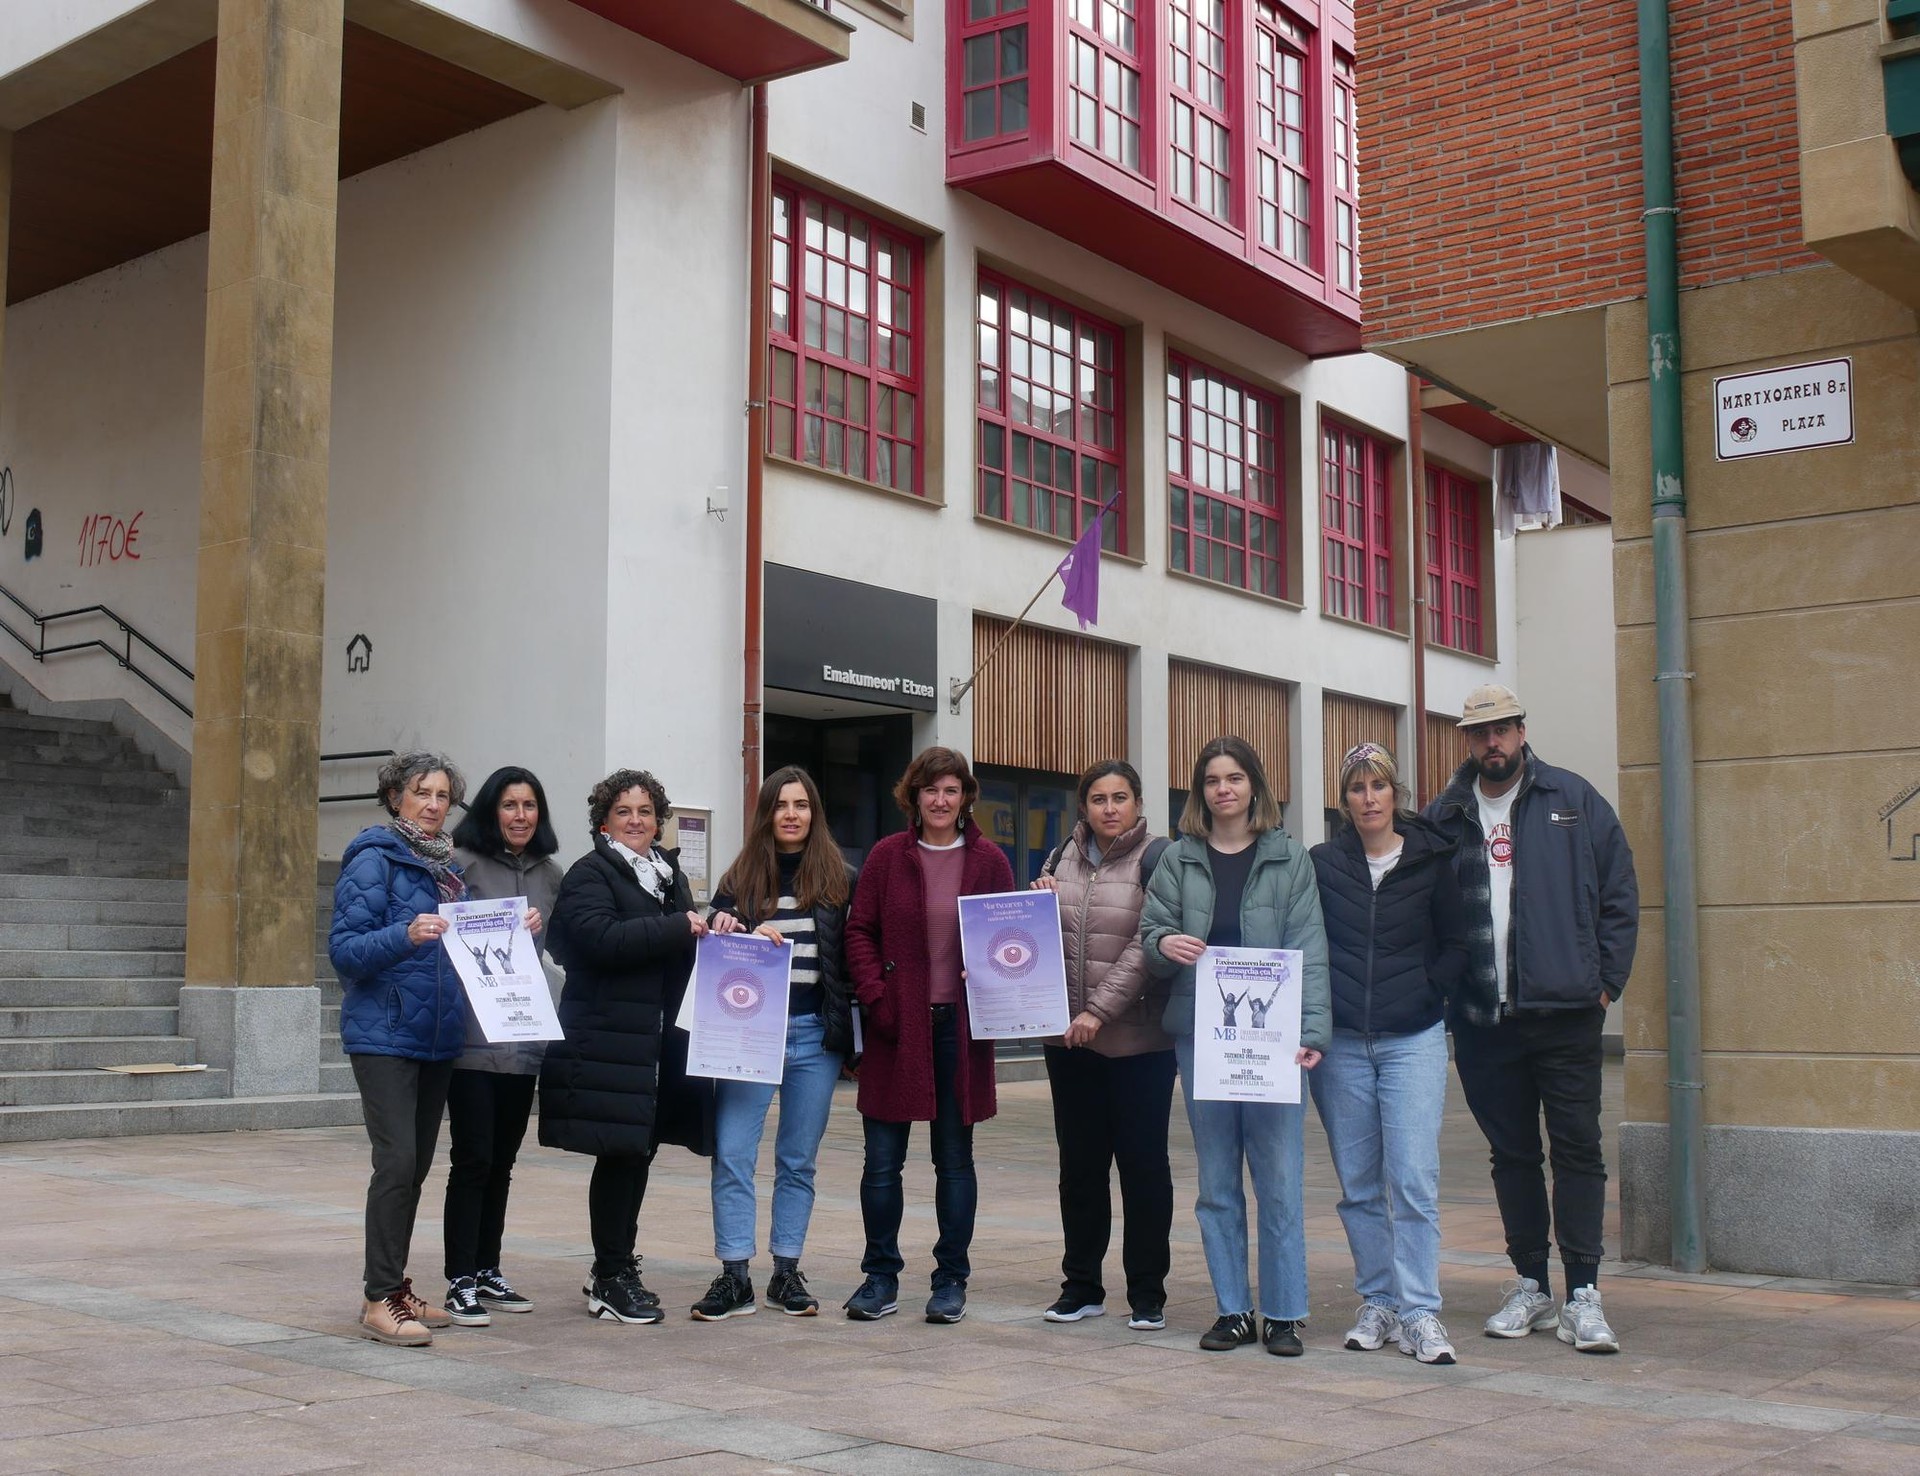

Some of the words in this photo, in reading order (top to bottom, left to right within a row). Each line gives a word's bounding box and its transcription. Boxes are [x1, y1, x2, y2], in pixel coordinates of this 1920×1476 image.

[1723, 382, 1821, 410] MARTXOAREN
[1782, 414, 1826, 432] PLAZA
[78, 510, 143, 567] 1170€
[902, 678, 934, 698] Etxea
[1213, 1027, 1237, 1041] M8
